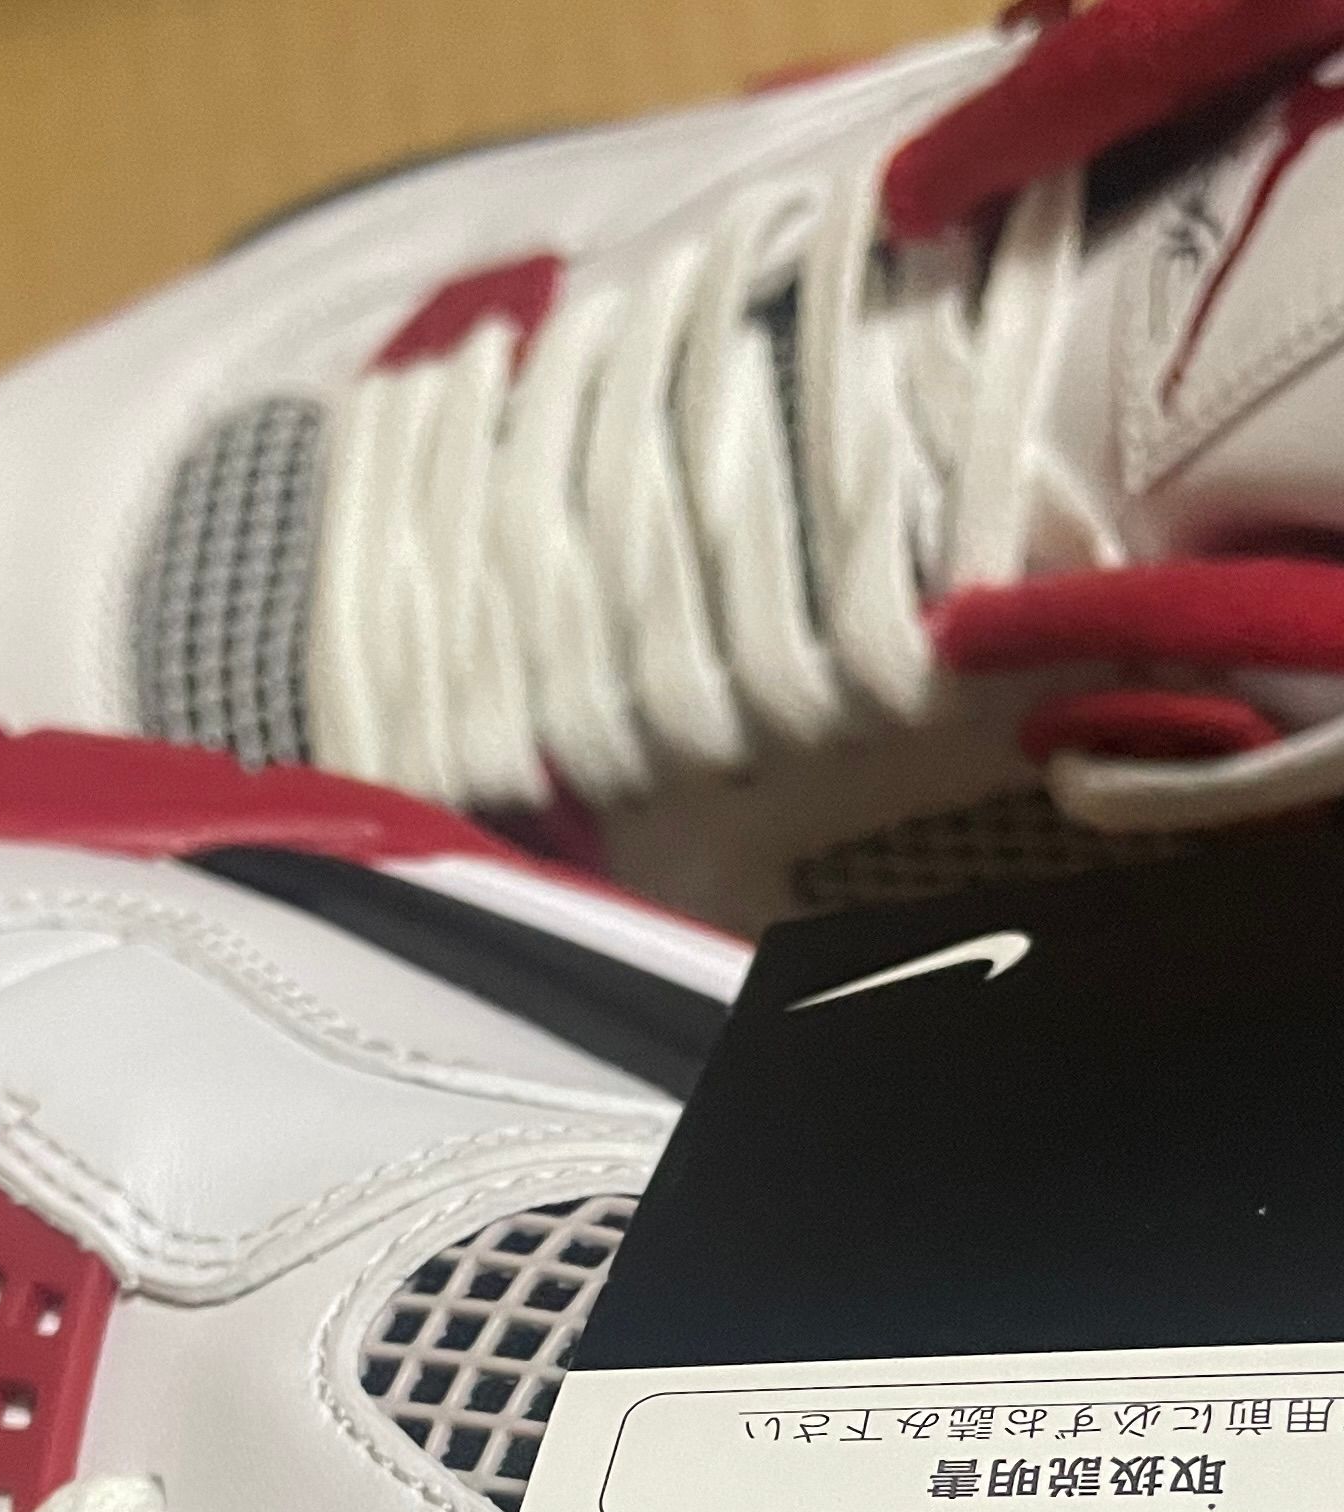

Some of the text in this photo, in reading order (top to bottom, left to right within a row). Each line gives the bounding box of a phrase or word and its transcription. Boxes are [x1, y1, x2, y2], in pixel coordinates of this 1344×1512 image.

[926, 1453, 1227, 1500] 取扱説明書
